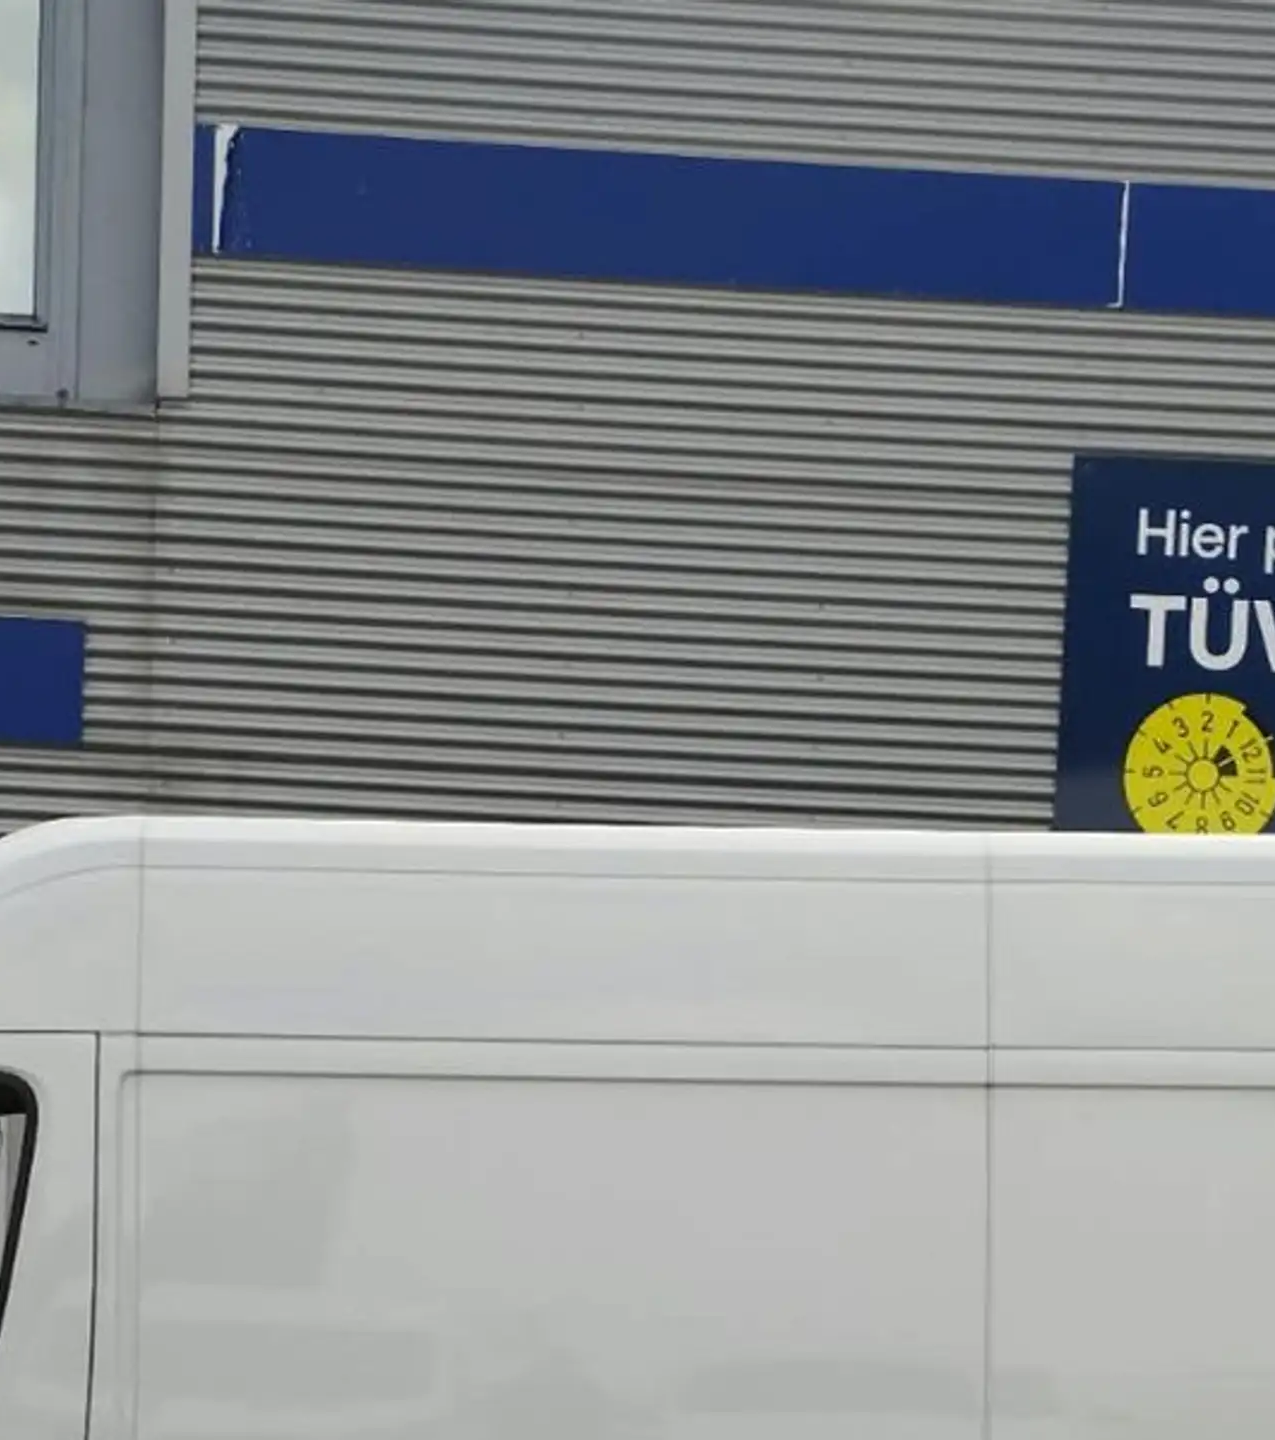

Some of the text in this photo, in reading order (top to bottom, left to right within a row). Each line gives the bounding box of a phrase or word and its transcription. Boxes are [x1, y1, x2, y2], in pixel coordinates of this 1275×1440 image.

[1136, 509, 1248, 560] Hier
[1172, 717, 1190, 738] 3
[1201, 711, 1214, 732] 2
[1153, 737, 1173, 754] 4
[1239, 738, 1262, 762] 12
[1142, 765, 1164, 778] 5
